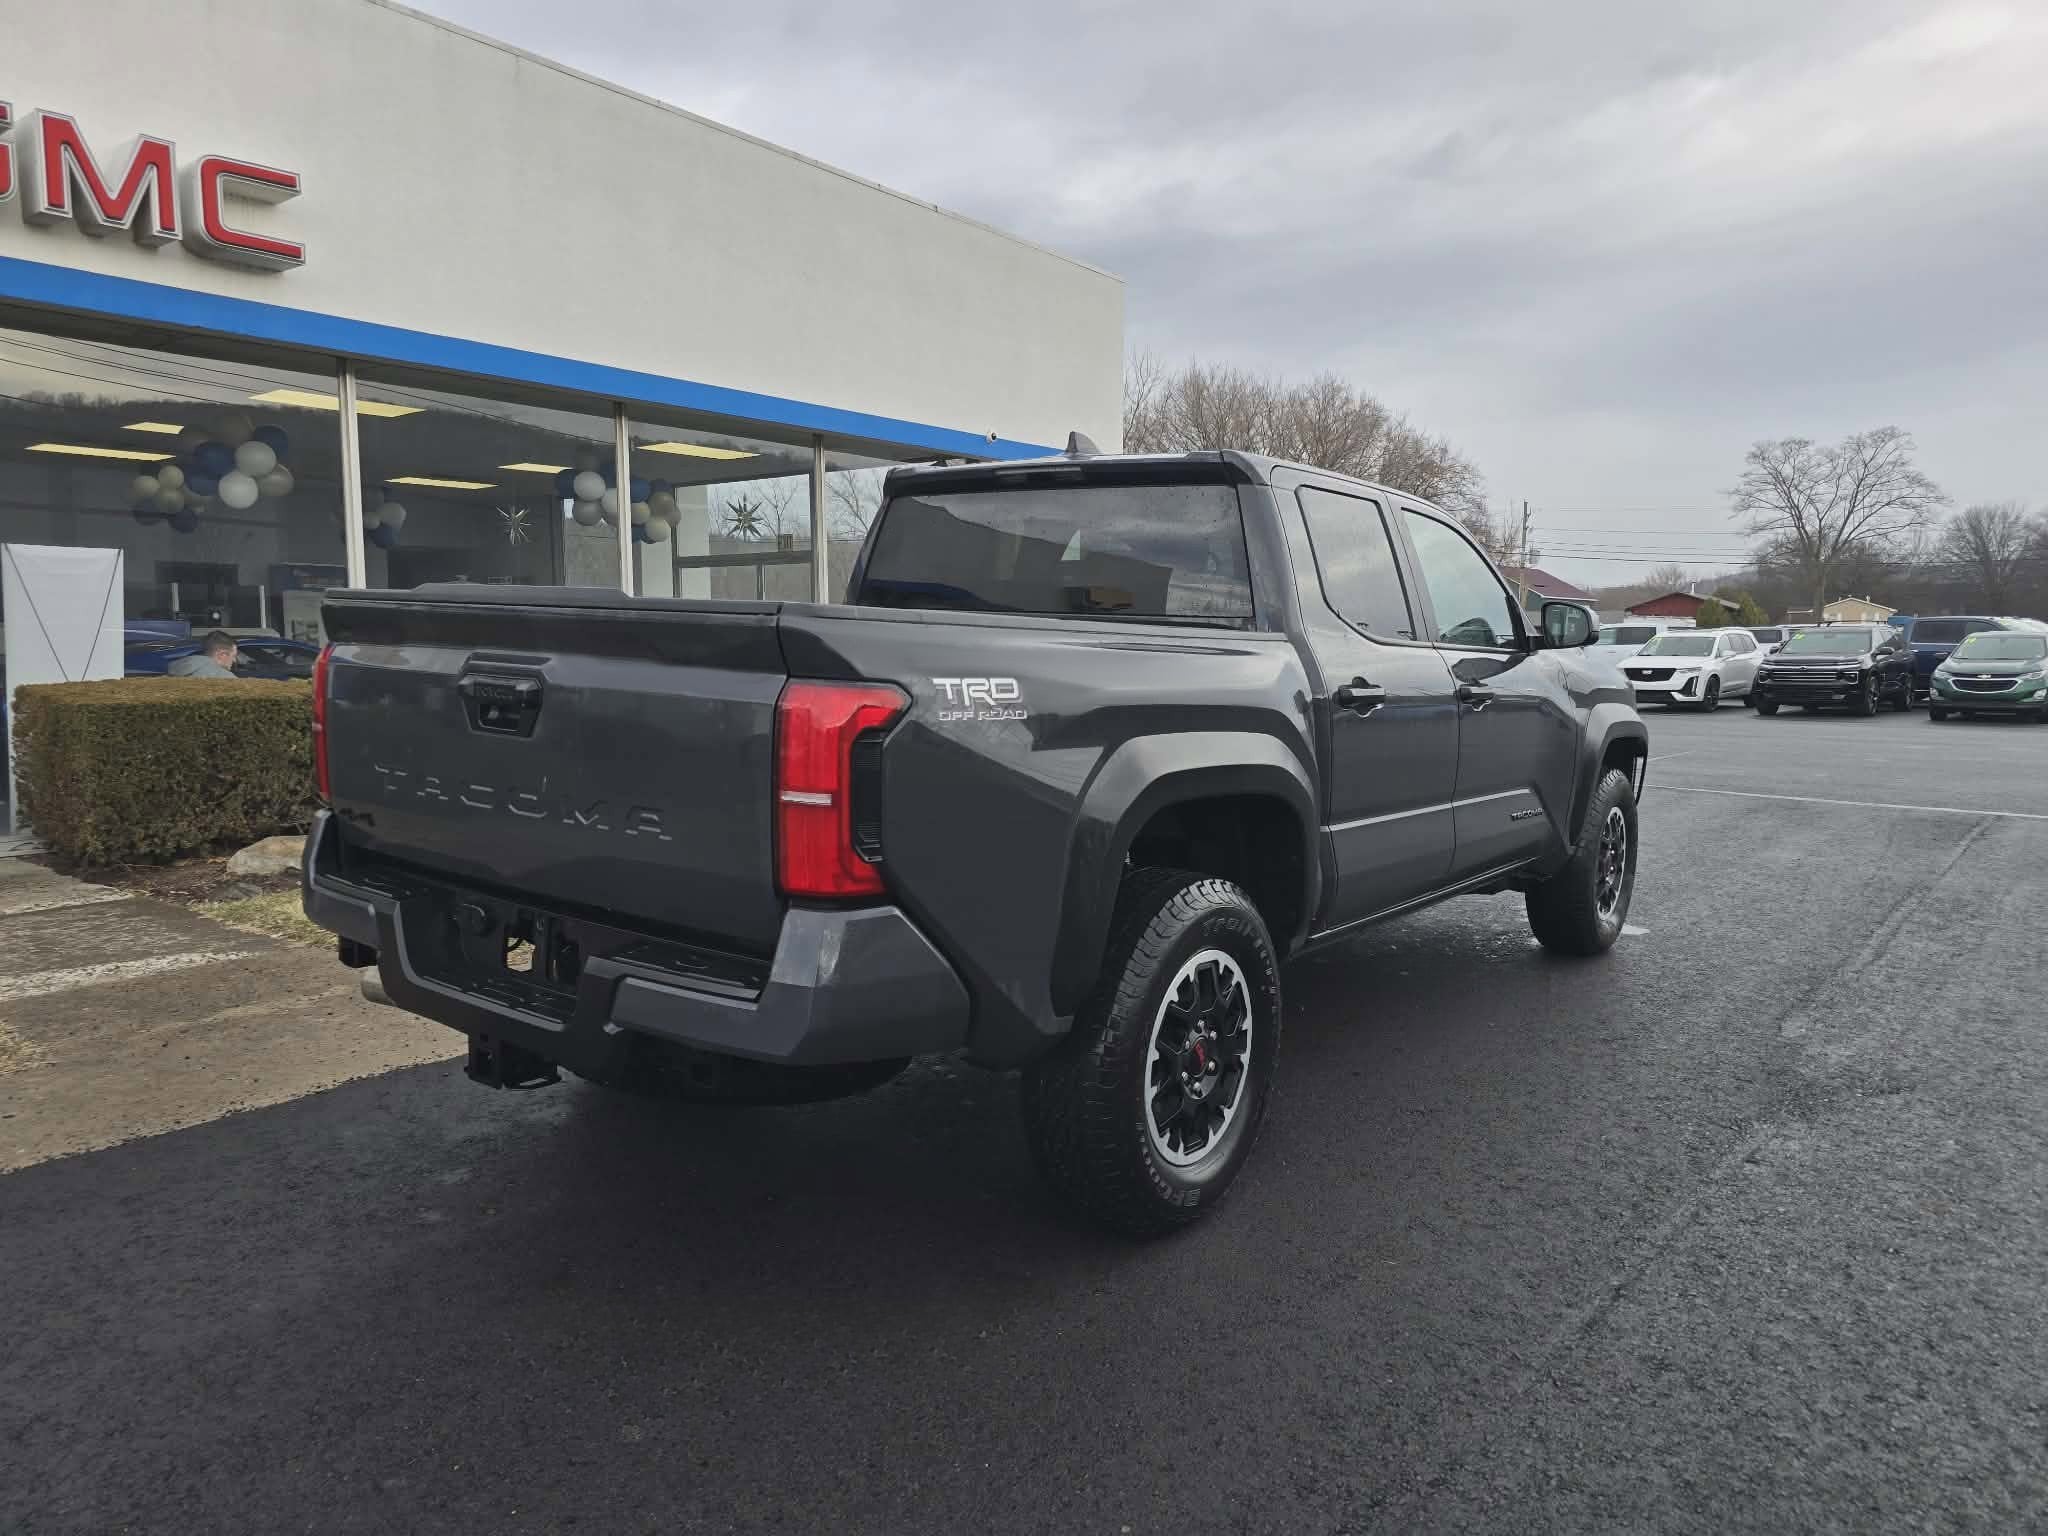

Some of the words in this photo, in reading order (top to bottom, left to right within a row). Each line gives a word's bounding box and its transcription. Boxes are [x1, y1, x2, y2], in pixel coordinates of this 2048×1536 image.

[0, 102, 305, 268] MC
[932, 677, 1019, 706] TRD
[938, 710, 975, 721] OFF
[977, 708, 1028, 720] ROAD
[373, 760, 673, 841] TACOMA
